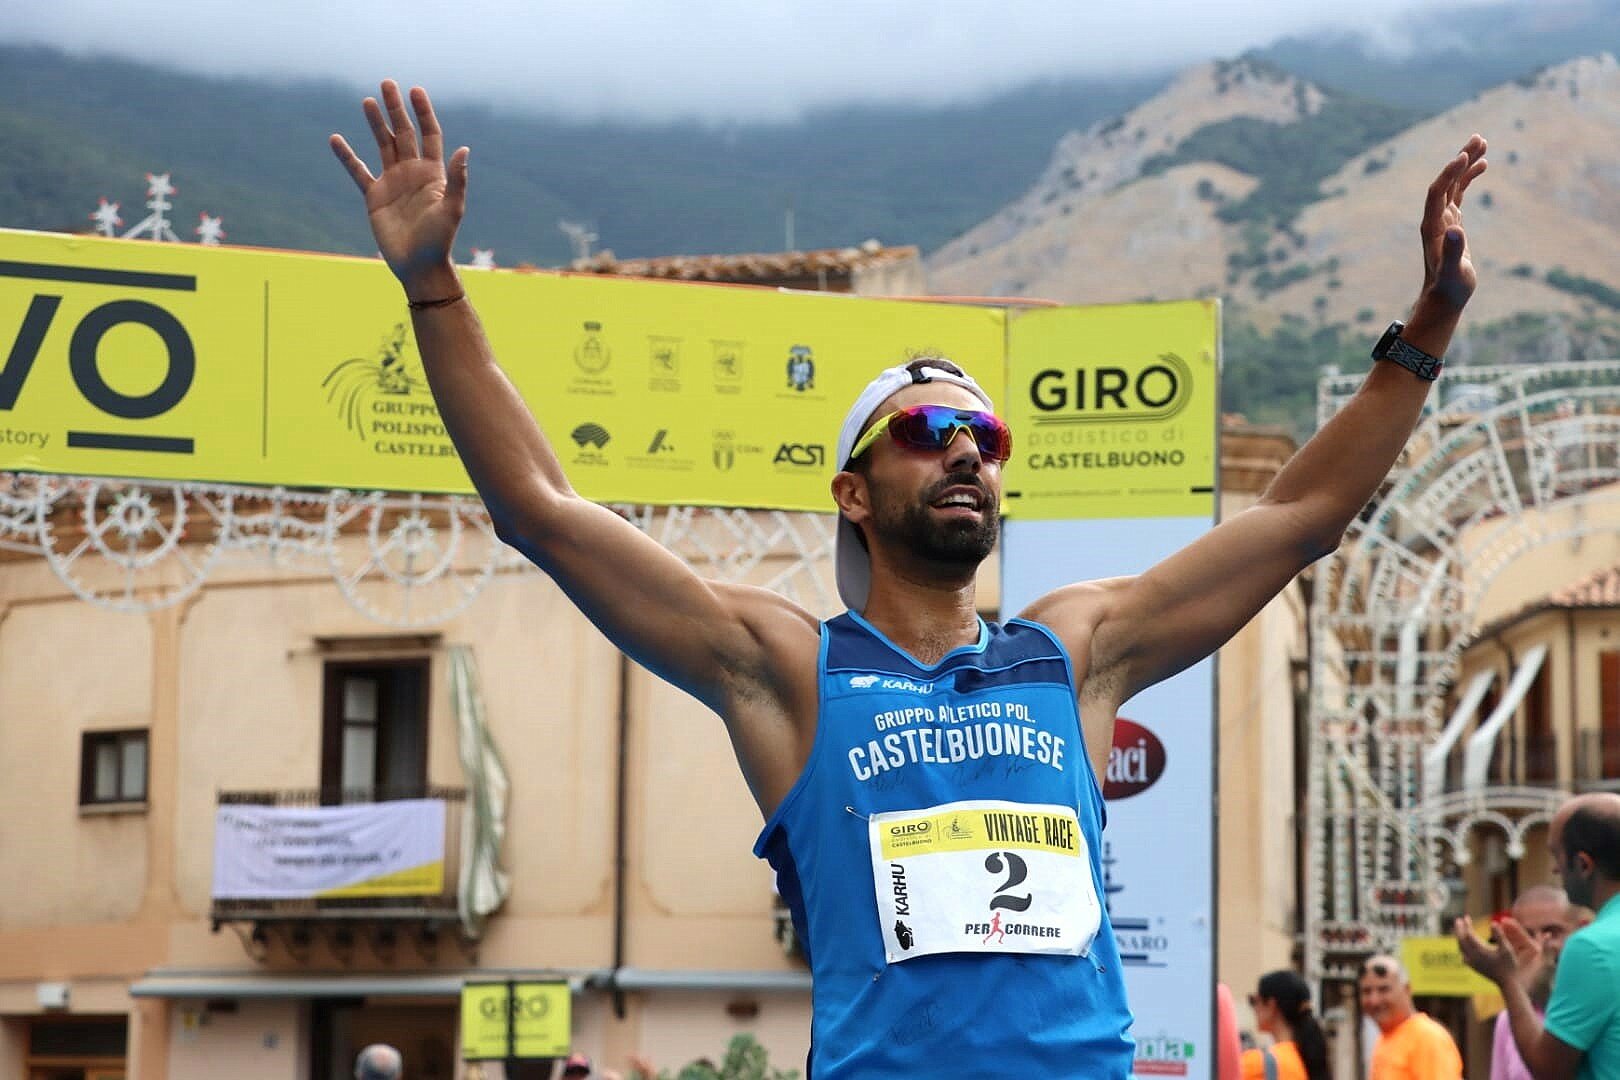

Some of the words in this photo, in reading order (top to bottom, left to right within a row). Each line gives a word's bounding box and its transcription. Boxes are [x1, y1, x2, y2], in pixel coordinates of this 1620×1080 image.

[1030, 365, 1179, 412] GIRO
[1028, 427, 1149, 447] podistico
[1028, 450, 1185, 470] CASTELBUONO
[882, 680, 934, 695] KARHU
[874, 706, 934, 732] GRUPPO
[939, 702, 1001, 725] ALETICO
[1005, 701, 1036, 723] POL.
[848, 722, 1065, 782] CASTELBUONESE
[890, 822, 929, 835] GIRO
[983, 813, 1041, 845] VINTAGE
[1044, 816, 1074, 850] RACE
[891, 863, 910, 916] KARHU
[984, 851, 1032, 912] 2
[964, 922, 991, 935] PER
